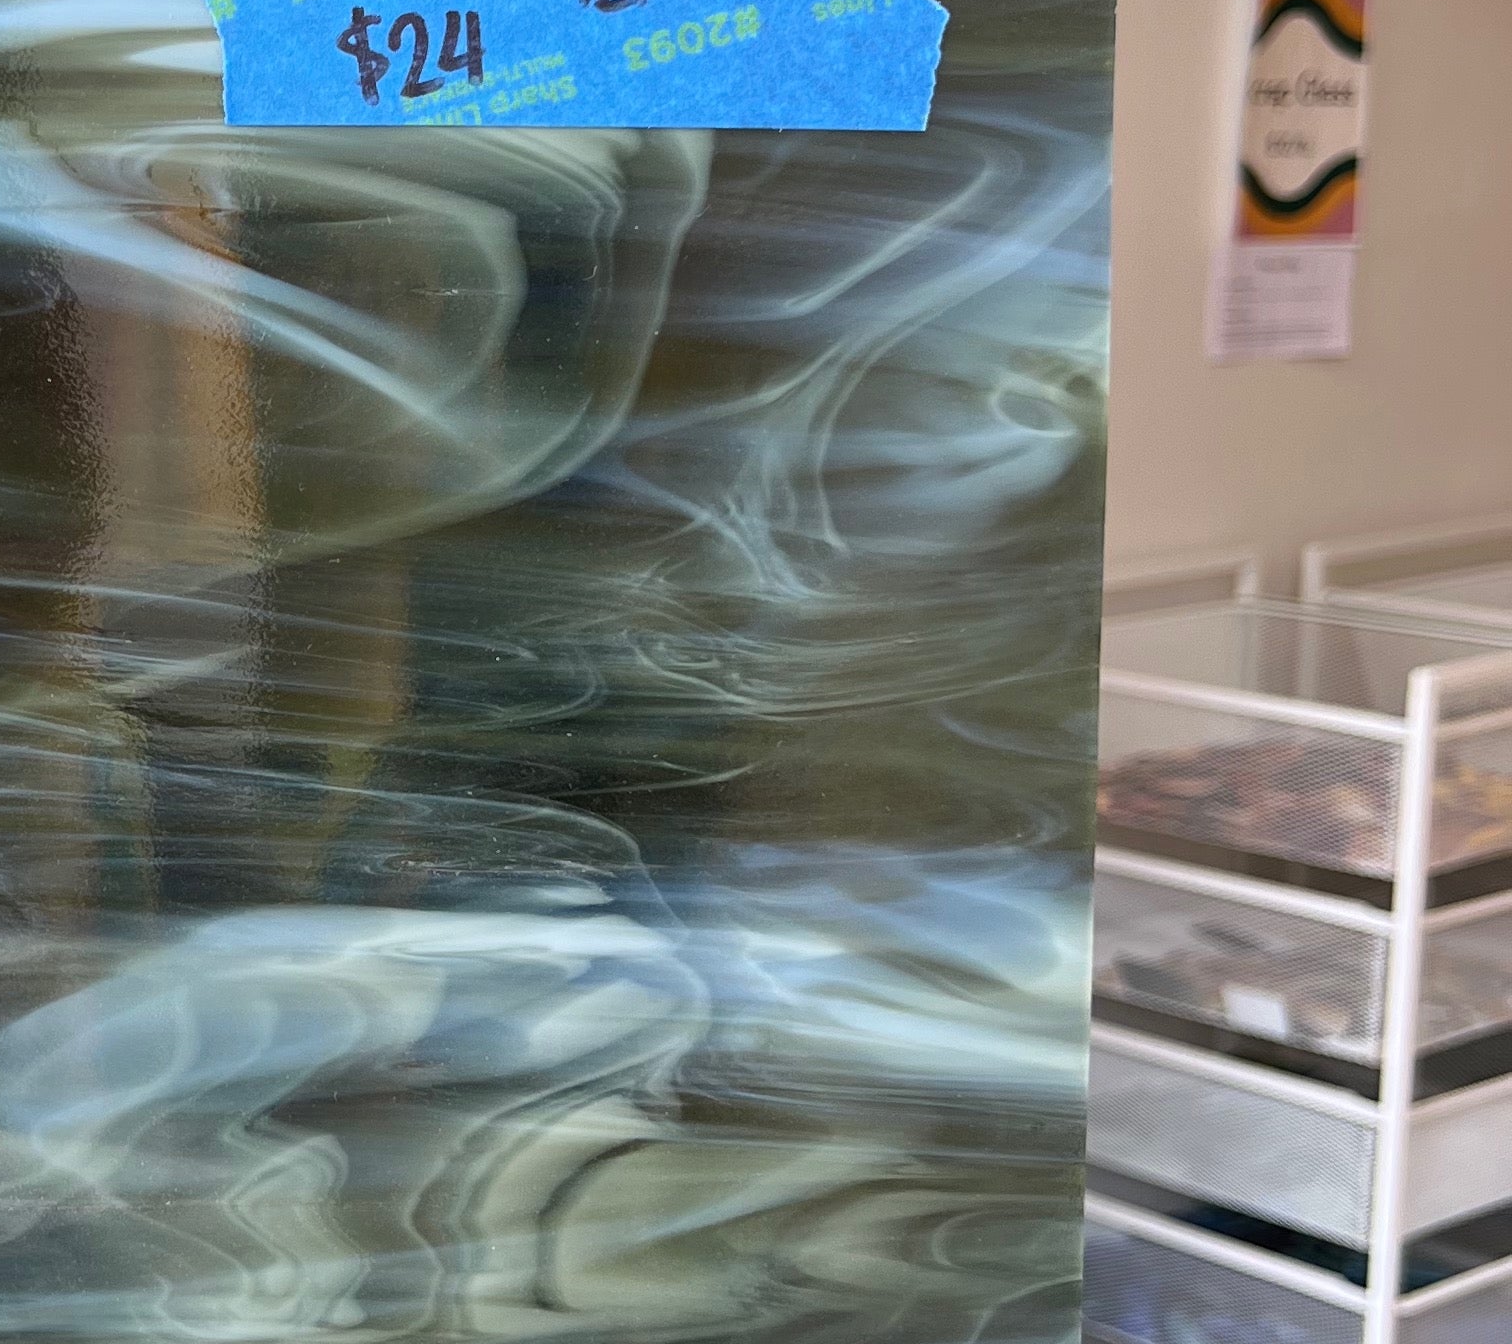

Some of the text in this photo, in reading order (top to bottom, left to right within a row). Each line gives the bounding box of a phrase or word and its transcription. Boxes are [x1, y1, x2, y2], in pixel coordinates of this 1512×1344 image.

[337, 6, 483, 106] $24
[622, 3, 763, 72] #2093
[488, 74, 578, 115] Sharp
